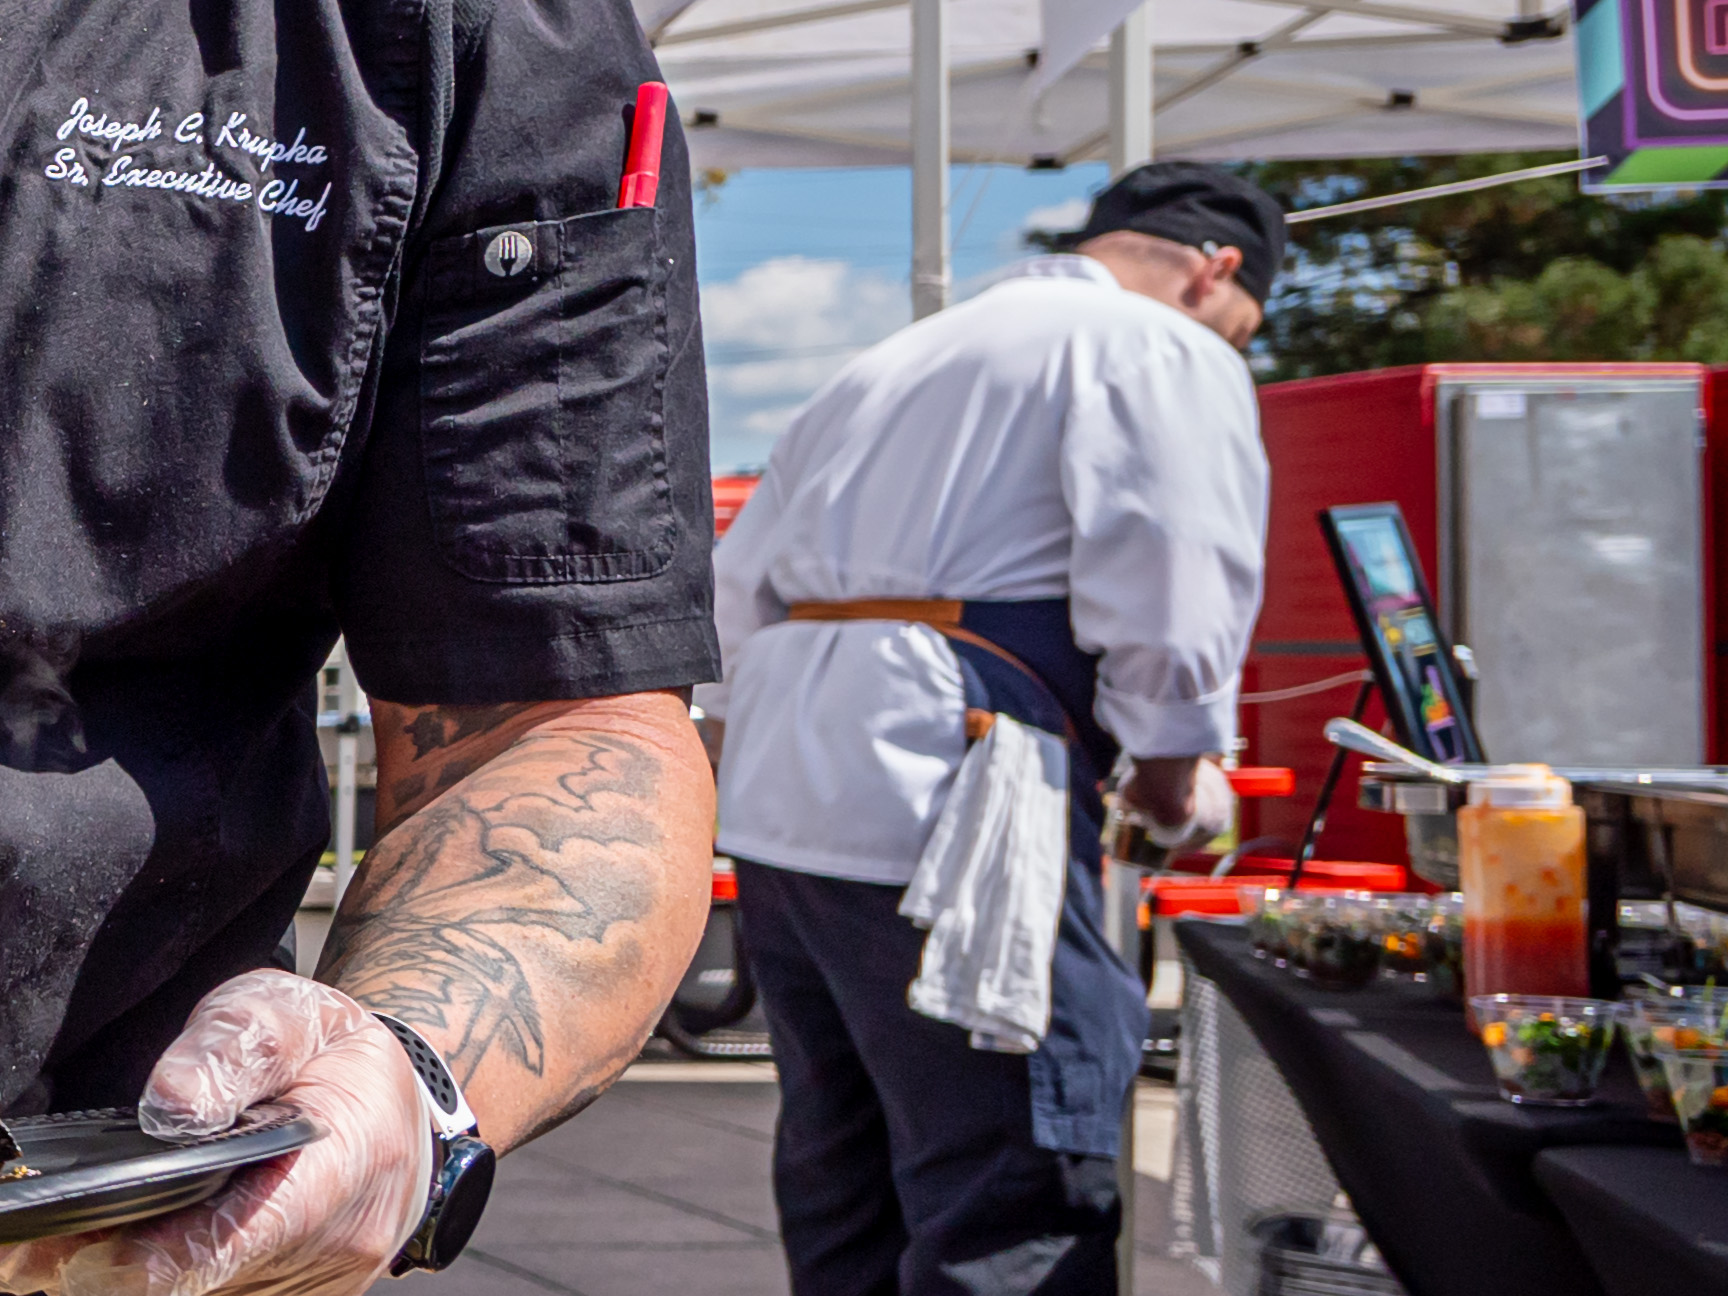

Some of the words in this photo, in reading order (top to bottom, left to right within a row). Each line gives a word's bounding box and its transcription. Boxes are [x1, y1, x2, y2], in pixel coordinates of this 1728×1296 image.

[56, 97, 162, 151] Joseph
[174, 112, 204, 145] C.
[215, 111, 329, 171] Krupka
[44, 148, 89, 187] Sr.
[101, 156, 253, 202] Executive
[258, 179, 333, 232] Chef
